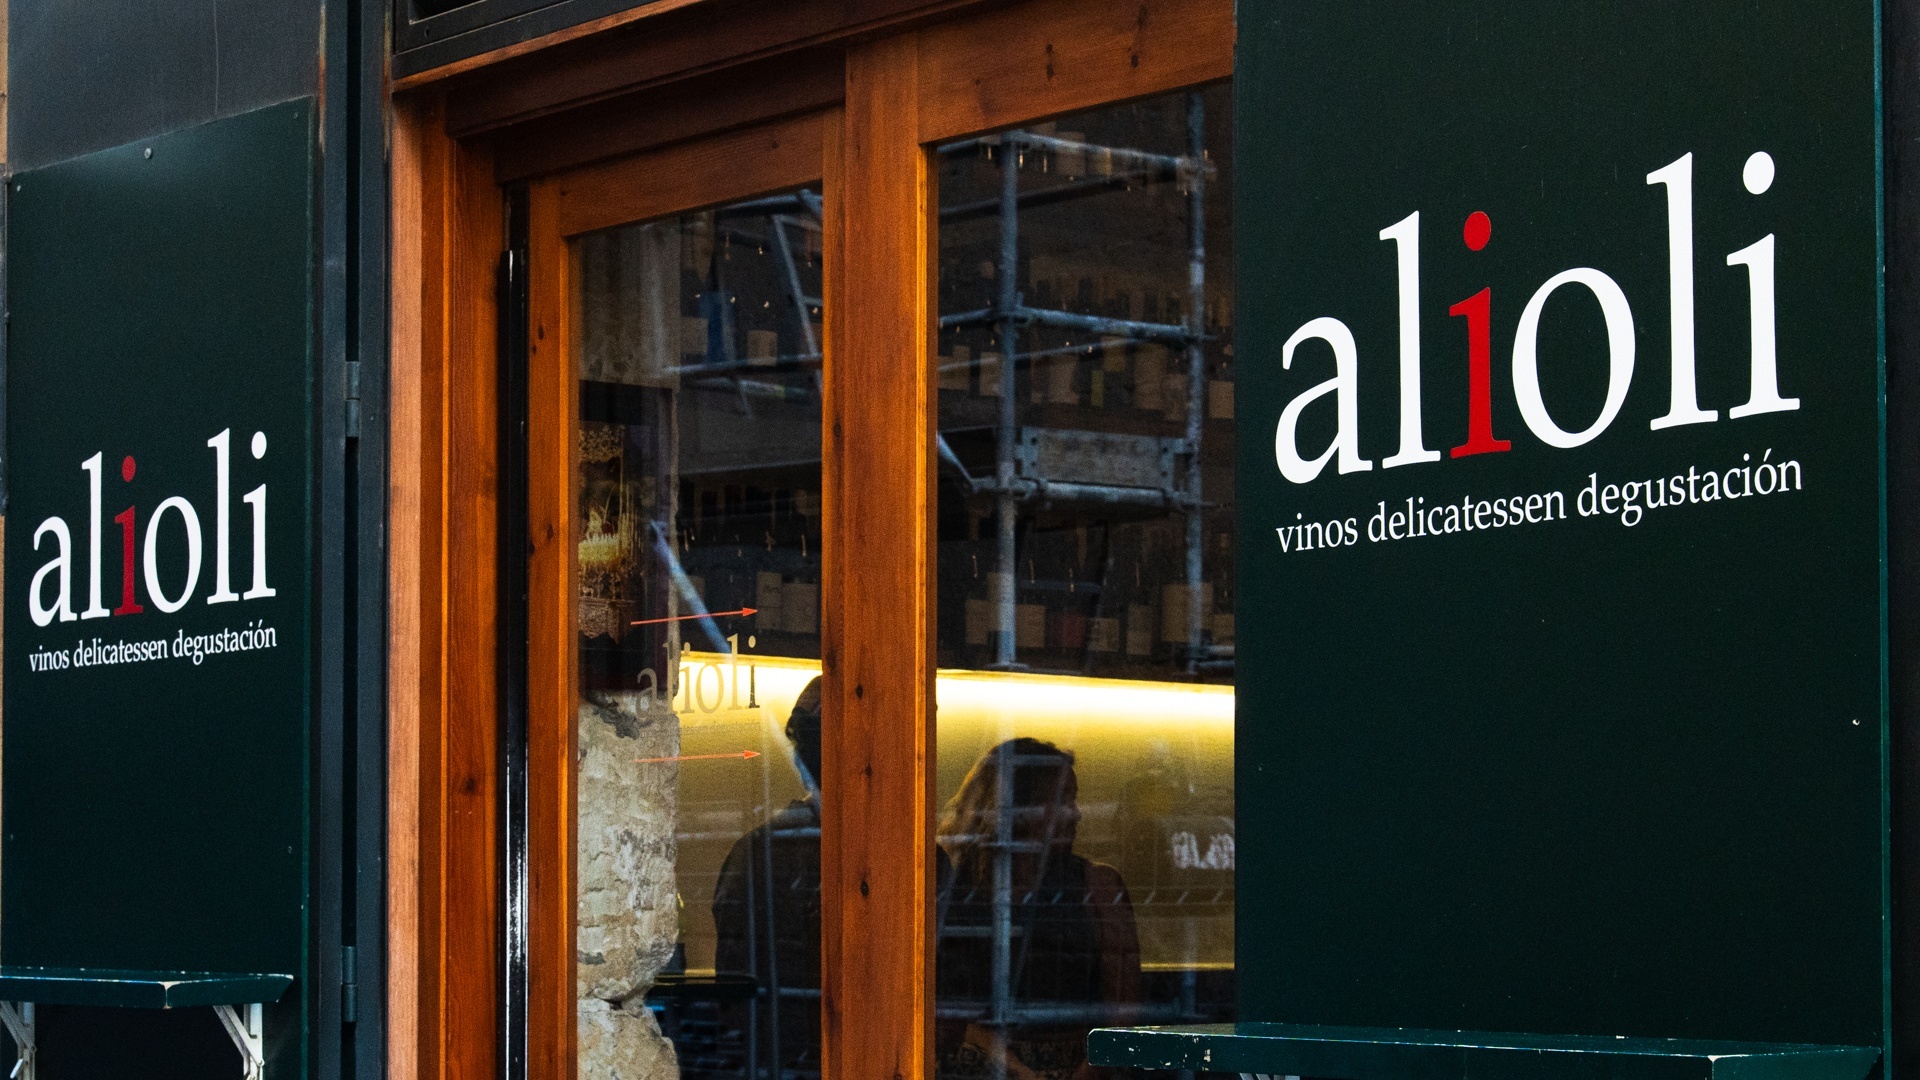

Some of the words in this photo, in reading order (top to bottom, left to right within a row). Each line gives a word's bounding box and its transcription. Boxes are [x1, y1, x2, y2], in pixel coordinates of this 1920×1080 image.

[1275, 150, 1801, 485] alioli
[28, 427, 277, 627] alioli
[1275, 512, 1359, 553] vinos
[1367, 490, 1568, 543] delicatessen
[1576, 447, 1802, 528] degustación
[28, 644, 70, 672] vinos
[73, 637, 169, 668] delicatessen
[173, 618, 278, 666] degustación
[635, 632, 761, 721] alioli
